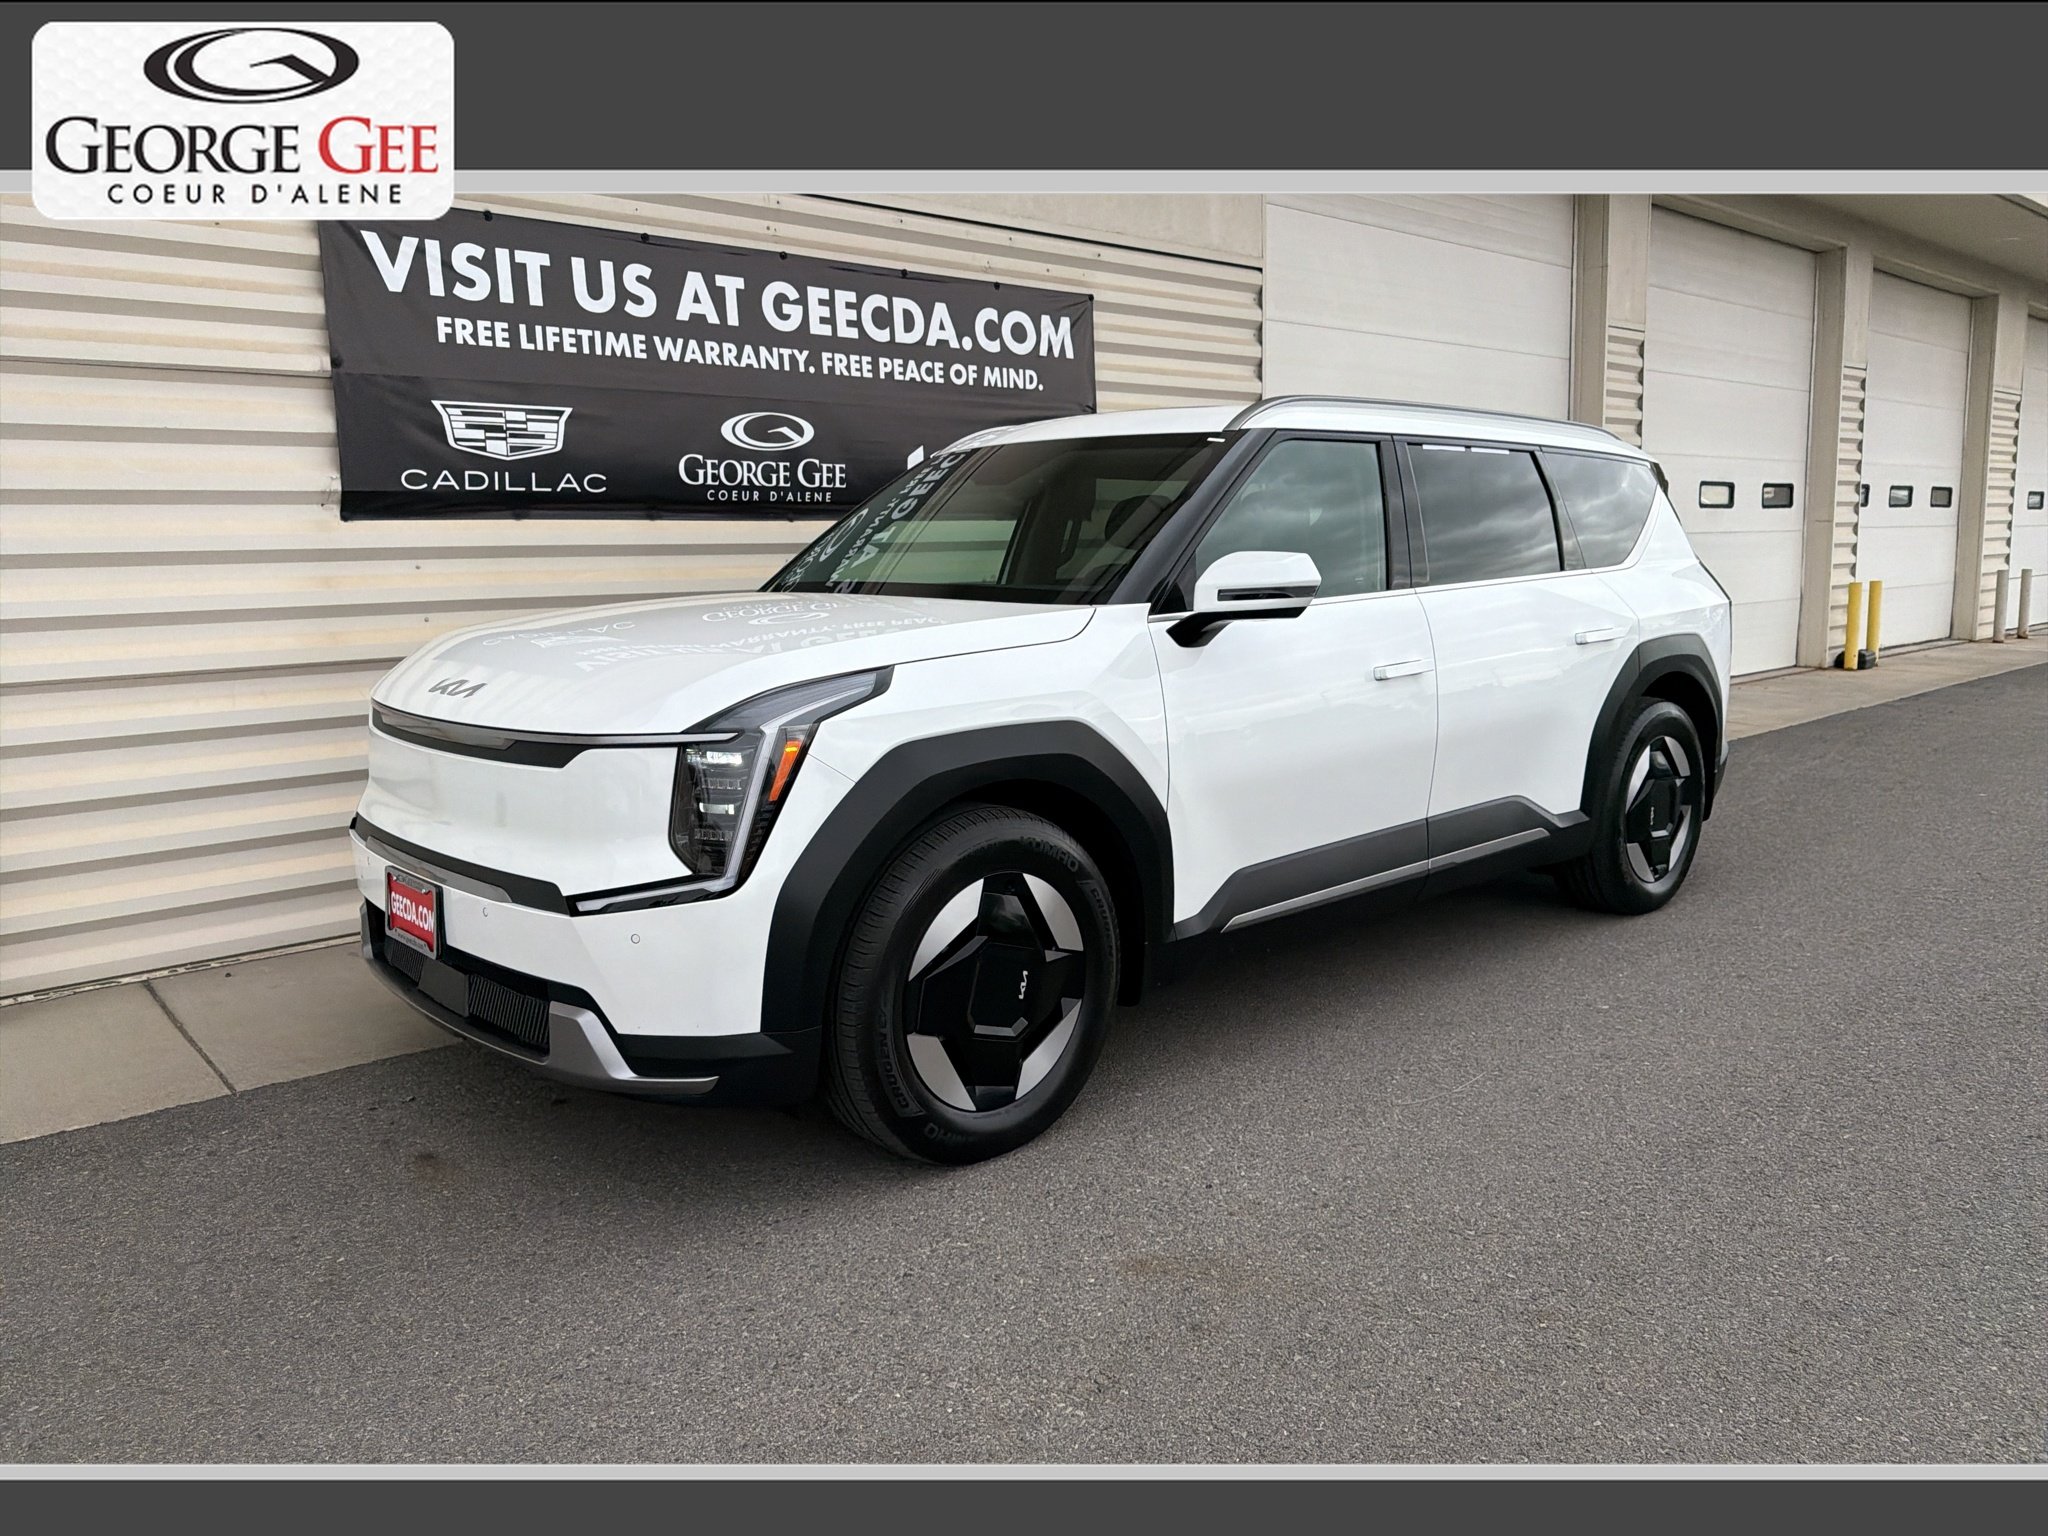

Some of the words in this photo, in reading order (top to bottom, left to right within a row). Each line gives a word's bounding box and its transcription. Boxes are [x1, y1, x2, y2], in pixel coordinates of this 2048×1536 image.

[359, 229, 551, 307] VISIT
[570, 256, 658, 318] US
[675, 270, 745, 327] AT
[761, 280, 1075, 360] GEECDA.COM
[436, 315, 511, 349] FREE
[518, 323, 648, 360] LIFETIME
[652, 335, 816, 374] WARRANTY.
[821, 351, 874, 379] FREE
[878, 356, 945, 384] PEACE
[949, 362, 978, 386] OF
[983, 365, 1044, 392] MIND.
[400, 468, 607, 493] CADILLAC
[678, 453, 791, 488] GEORGE
[797, 458, 847, 488] GEE
[707, 489, 759, 501] COEUR
[769, 491, 832, 502] D'ALENE
[428, 678, 488, 698] KIA
[390, 891, 435, 933] GEECDA.COM
